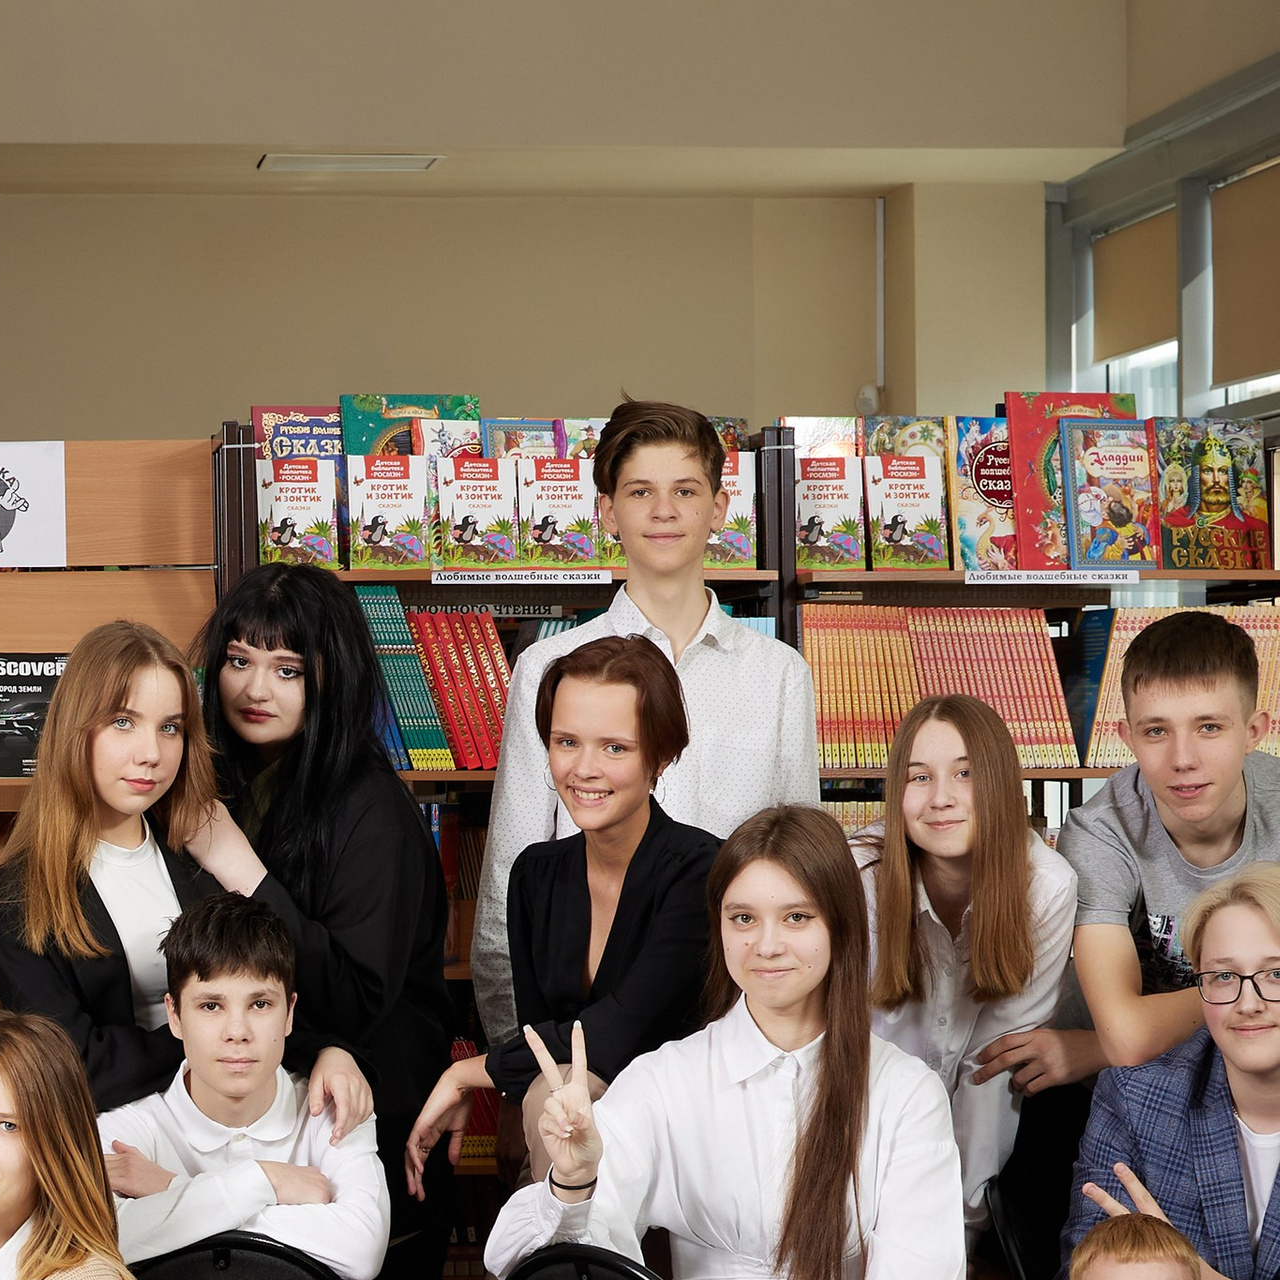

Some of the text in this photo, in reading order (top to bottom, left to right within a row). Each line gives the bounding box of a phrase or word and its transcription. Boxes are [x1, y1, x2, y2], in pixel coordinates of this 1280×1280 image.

[1088, 451, 1144, 467] Аладдин
[279, 486, 317, 494] КРОТИК
[370, 483, 409, 491] КРОТИК
[460, 484, 498, 492] КРОТИК
[541, 484, 579, 493] КРОТИК
[807, 484, 844, 492] КРОТИК
[888, 483, 925, 491] КРОТИК
[366, 492, 414, 500] И ЗОНТИК
[456, 493, 463, 501] И
[536, 493, 583, 501] И ЗОНТИК
[812, 492, 849, 500] ЗОНТИК
[1171, 527, 1267, 551] РУССКИЕ
[1171, 550, 1268, 570] СКАЗКИ
[436, 572, 601, 582] Любимые волшебные сказки
[968, 572, 1128, 583] Любимые волшебные сказки
[492, 605, 552, 615] ЧТЕНИЯ
[18, 685, 42, 693] ЗЕМЛИ
